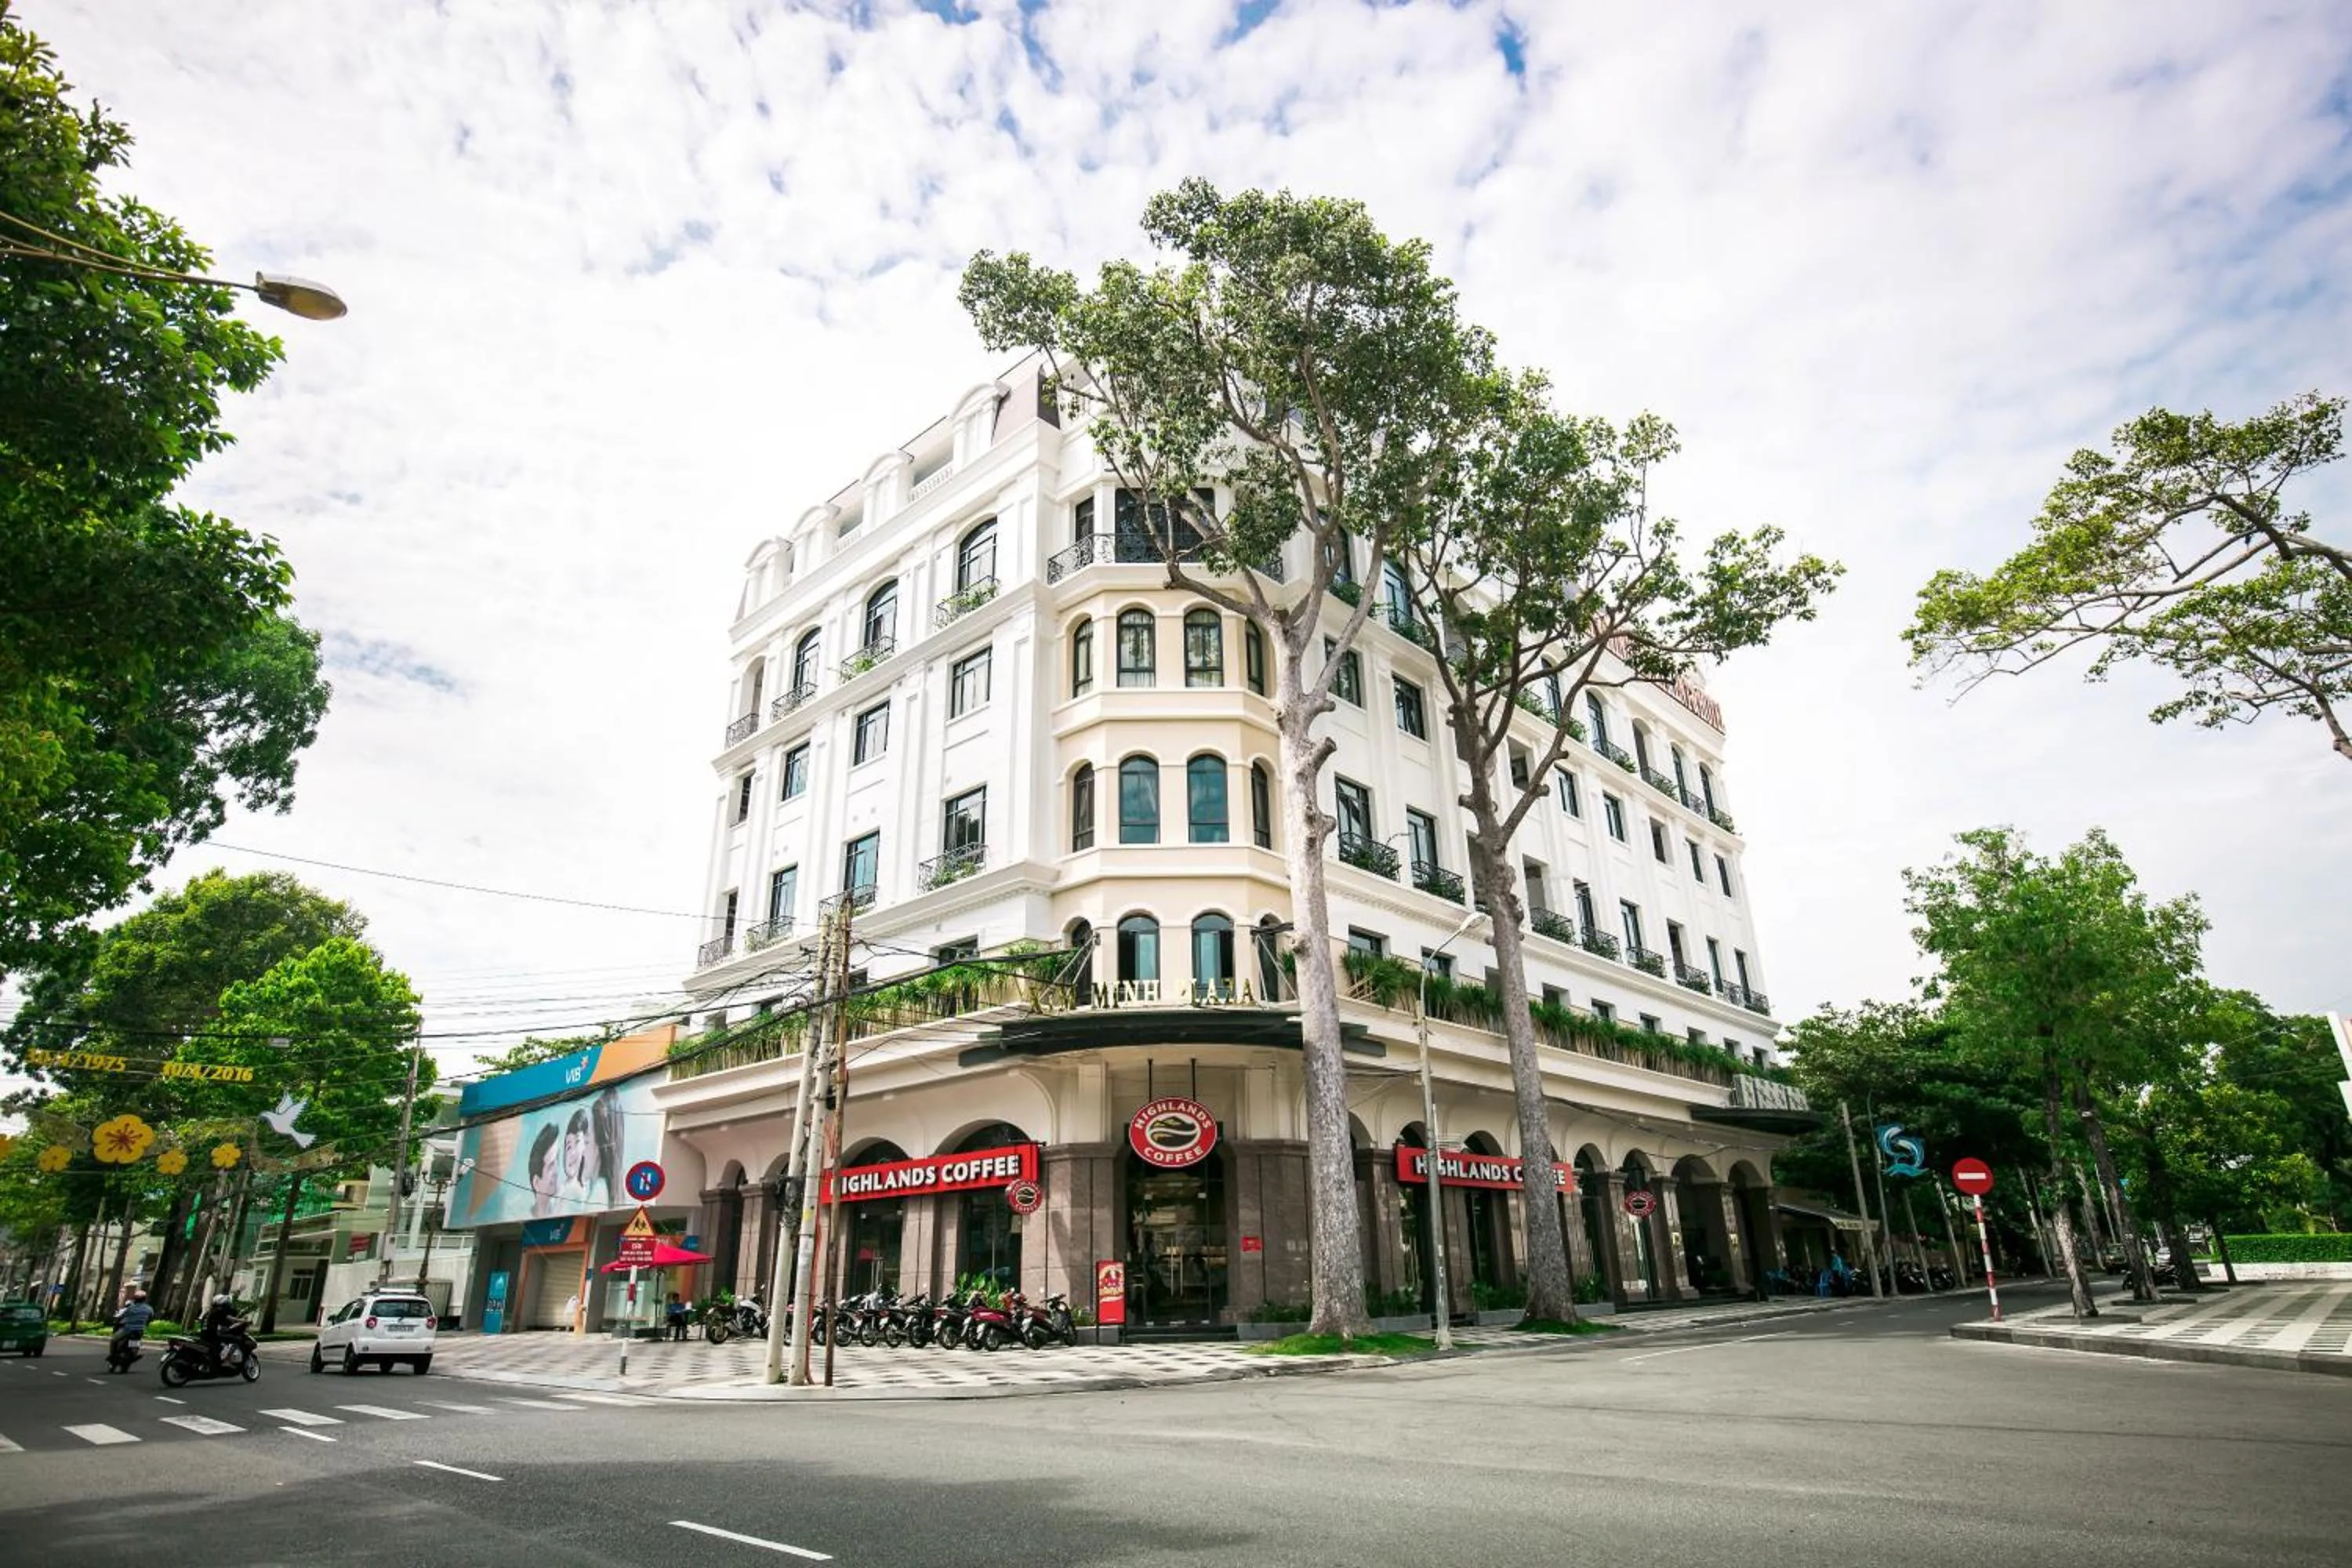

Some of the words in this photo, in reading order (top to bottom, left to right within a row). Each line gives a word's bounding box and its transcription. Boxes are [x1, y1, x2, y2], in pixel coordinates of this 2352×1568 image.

[1091, 979, 1161, 1009] MINH
[565, 1066, 581, 1084] VIB
[1134, 1102, 1212, 1130] HIGHLANDS
[1145, 1145, 1203, 1162] COFFEE
[942, 1155, 1019, 1183] COFFEE
[1415, 1156, 1510, 1181] HGHLANDS
